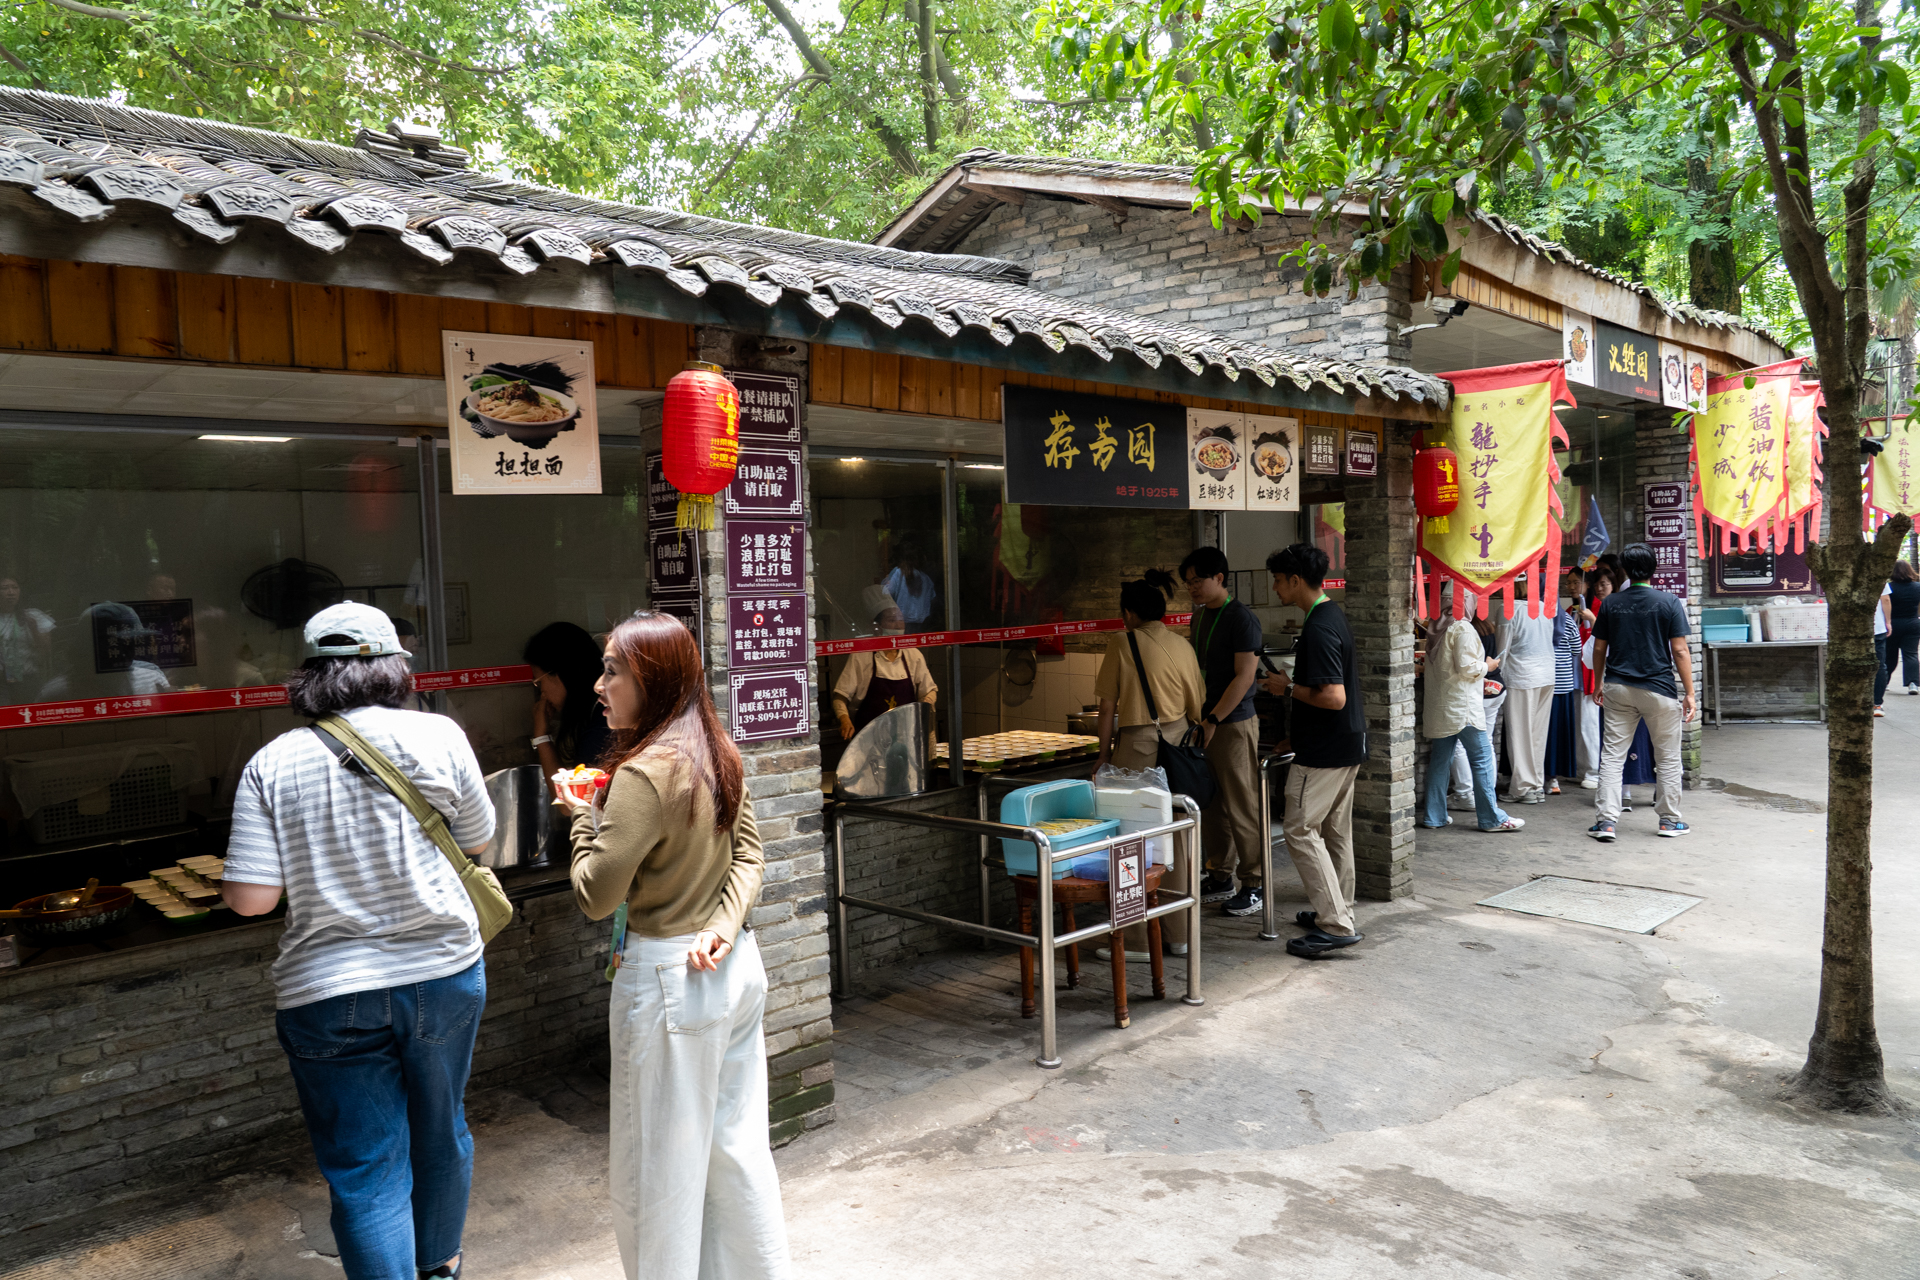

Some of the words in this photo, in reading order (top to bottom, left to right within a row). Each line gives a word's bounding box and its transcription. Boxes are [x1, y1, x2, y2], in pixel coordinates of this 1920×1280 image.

[1748, 402, 1775, 483] 酱油饭
[494, 451, 563, 477] 担担面
[1311, 453, 1334, 464] 禁止打包
[738, 464, 788, 481] 自助品尝
[744, 481, 783, 498] 请自取
[1116, 486, 1180, 498] 始于1925年
[740, 534, 792, 548] 少量多次
[657, 543, 687, 560] 自助品尝
[740, 548, 793, 563] 浪费可耻
[661, 560, 685, 576] 请自取
[741, 562, 793, 577] 禁止打包
[742, 599, 791, 612] 温馨提示
[735, 626, 802, 639] 禁止打包，现场有
[735, 638, 798, 651] 监控，发现打包，
[753, 687, 788, 700] 现场烹饪
[112, 699, 152, 710] 小心玻璃
[739, 697, 802, 713] 请联系工作人员：
[739, 708, 803, 724] 139-8094-0712
